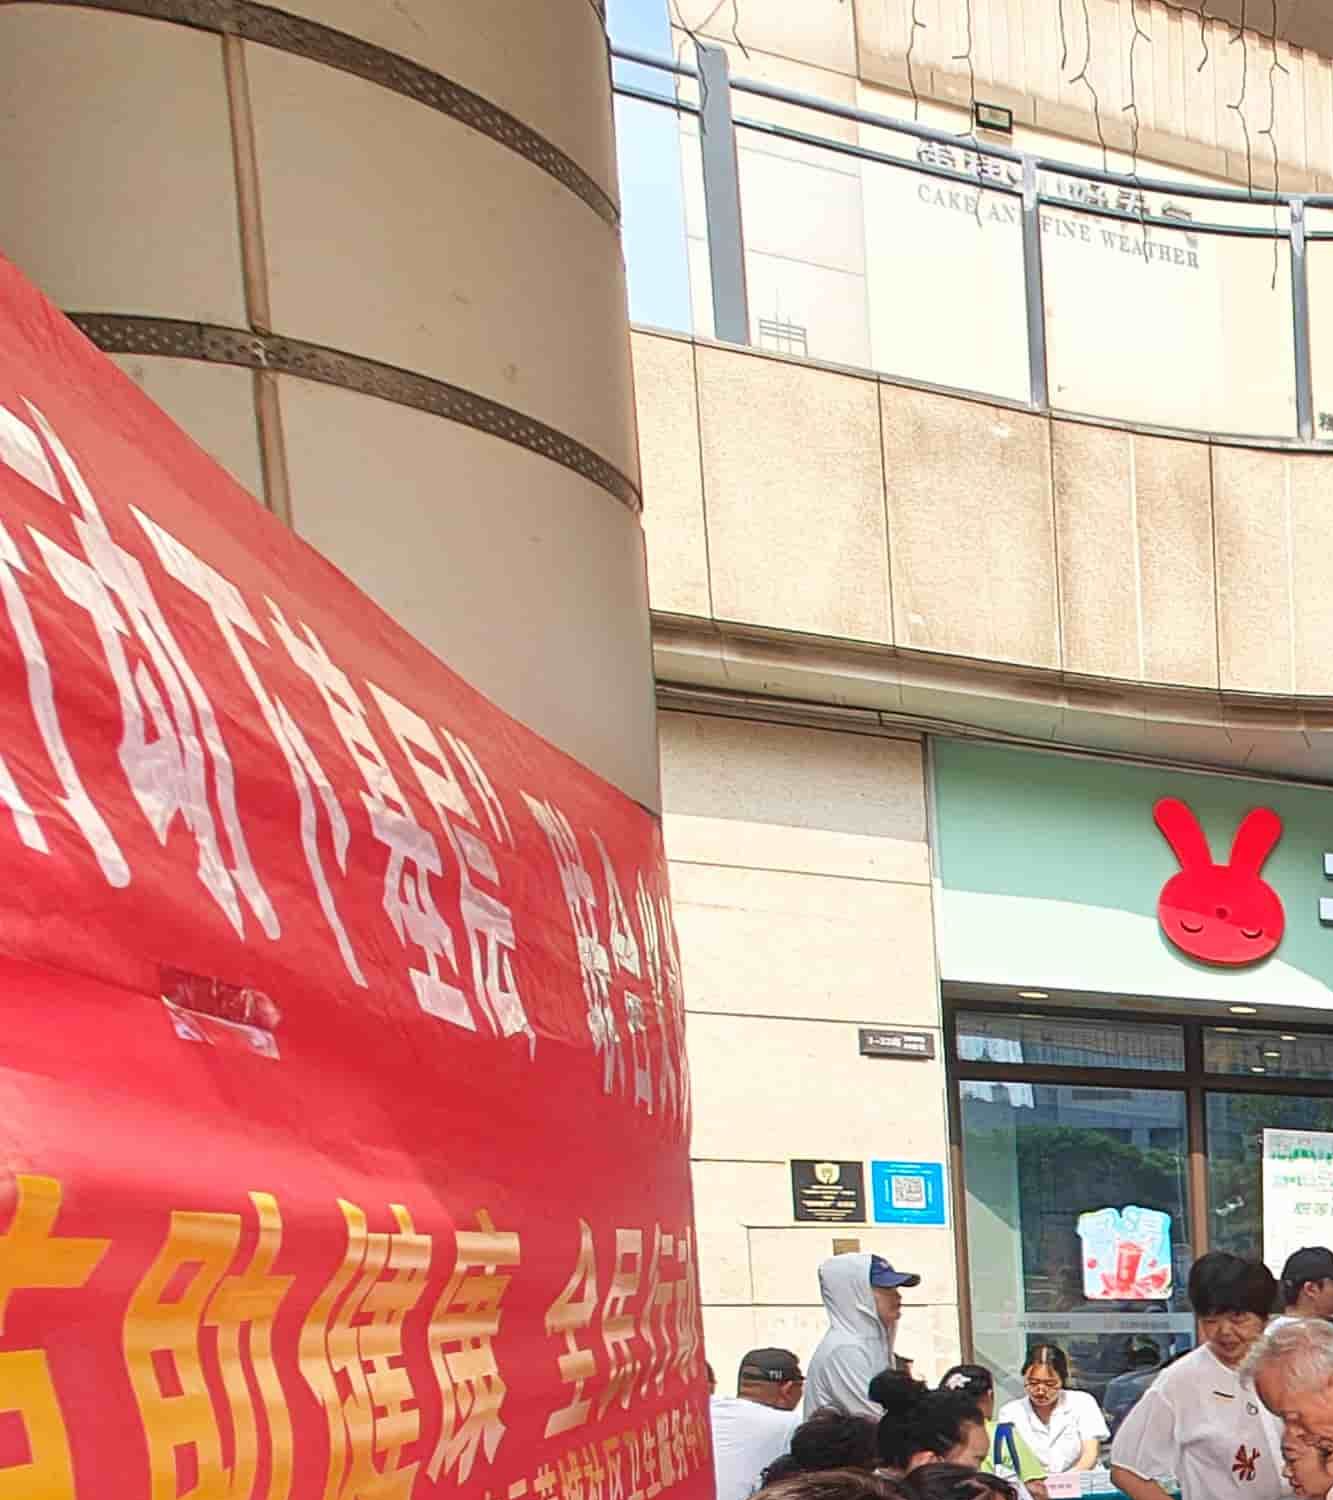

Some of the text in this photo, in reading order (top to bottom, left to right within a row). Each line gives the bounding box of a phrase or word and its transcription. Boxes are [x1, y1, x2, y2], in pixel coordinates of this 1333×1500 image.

[918, 183, 1200, 269] CAKE AN FINE WEATHER
